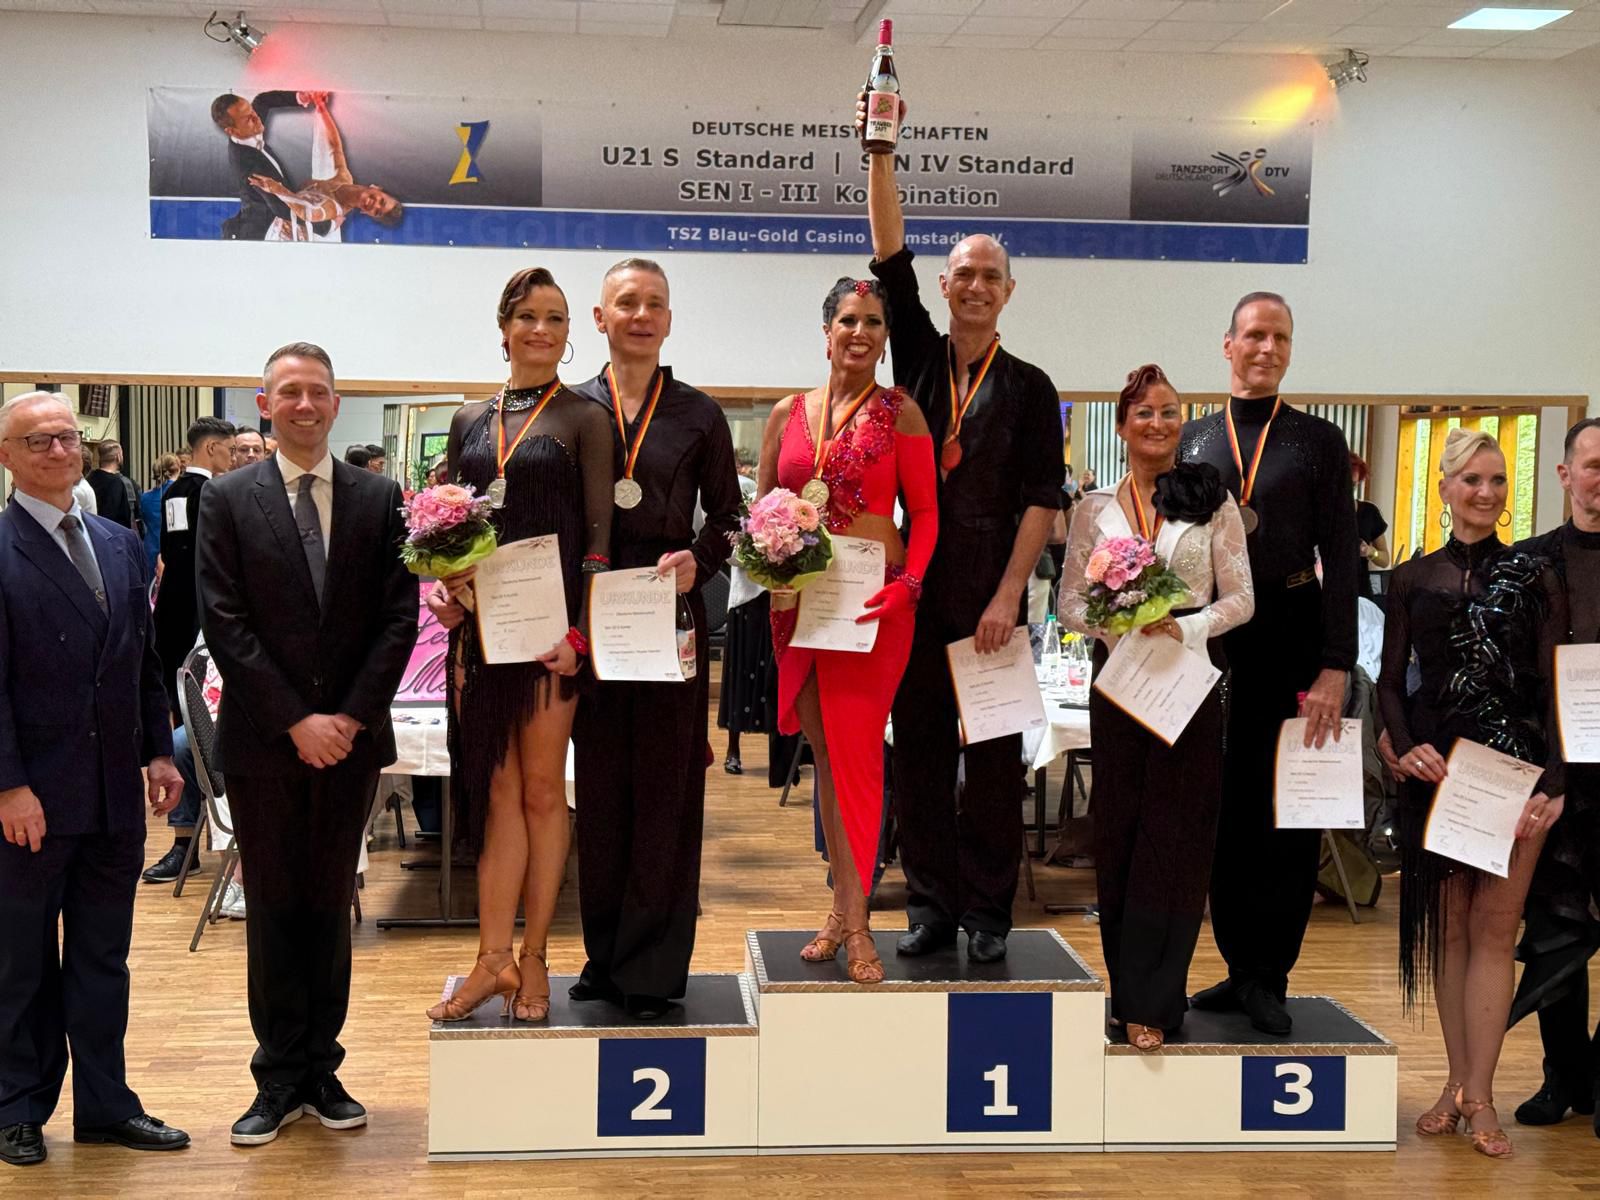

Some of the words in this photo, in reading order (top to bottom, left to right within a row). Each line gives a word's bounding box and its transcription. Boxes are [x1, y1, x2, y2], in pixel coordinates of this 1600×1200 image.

[692, 121, 794, 137] DEUTSCHE
[802, 124, 989, 142] MEISTCHAFTEN
[602, 146, 653, 166] U21
[663, 148, 680, 167] S
[696, 149, 815, 171] Standard
[861, 154, 911, 172] SN
[920, 154, 949, 173] IV
[958, 155, 1075, 176] Standard
[1171, 164, 1230, 175] TANZSPORT
[1265, 167, 1290, 178] DTV
[680, 181, 732, 201] SEN
[780, 184, 819, 203] III
[835, 185, 999, 207] Kobination
[668, 227, 701, 241] TSZ
[709, 227, 799, 243] Blau-Gold
[805, 229, 866, 245] Casino
[630, 1067, 672, 1121] 2
[983, 1064, 1018, 1116] 1
[1272, 1062, 1314, 1115] 3
